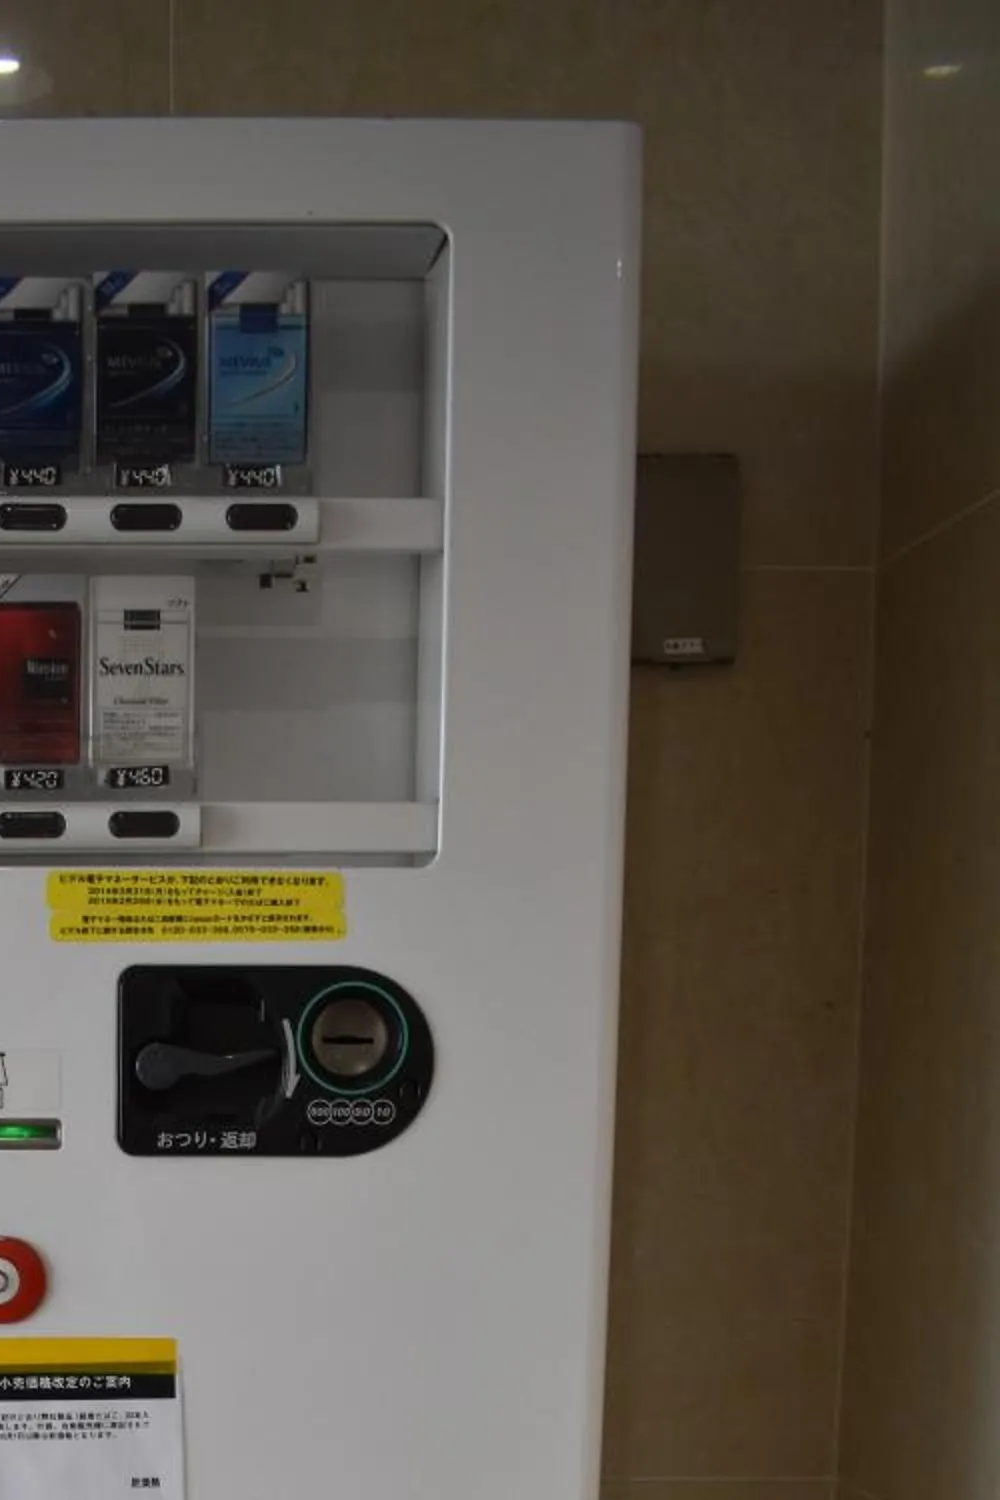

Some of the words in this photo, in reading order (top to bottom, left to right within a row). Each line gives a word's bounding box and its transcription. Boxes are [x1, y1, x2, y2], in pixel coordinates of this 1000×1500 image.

[376, 1107, 391, 1117] 10
[158, 1131, 256, 1149] おつり・返却
[0, 1375, 131, 1390] 小売価格改定のご案内
